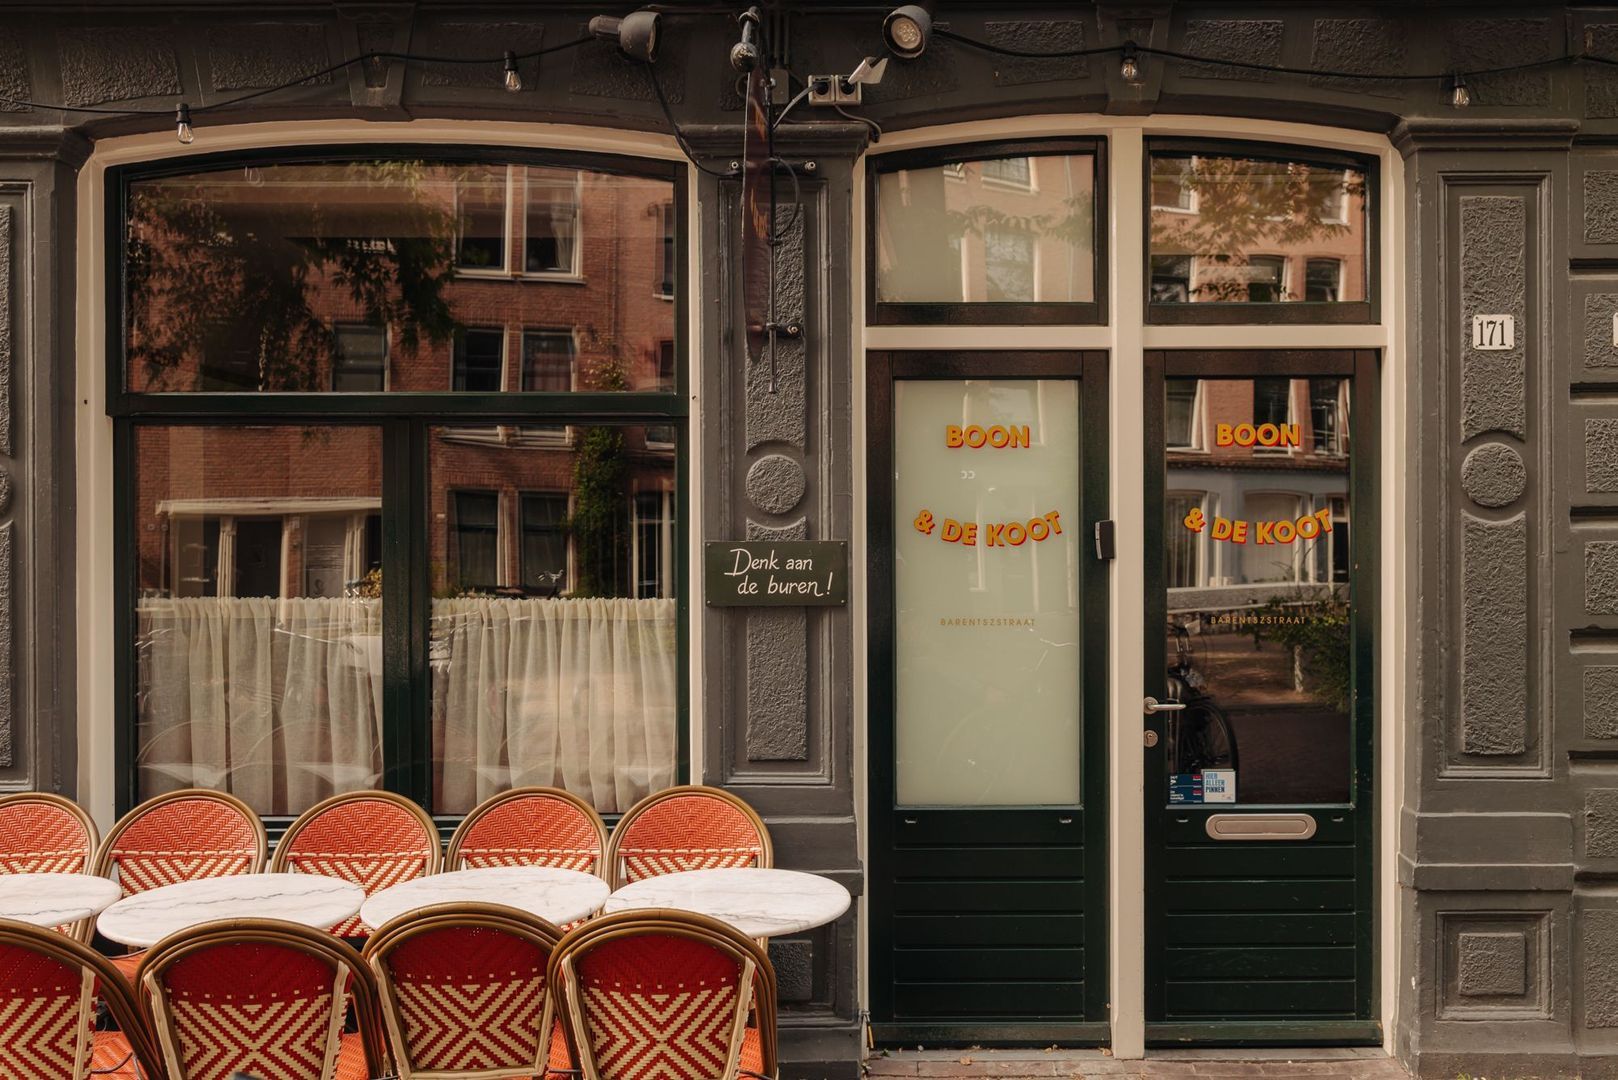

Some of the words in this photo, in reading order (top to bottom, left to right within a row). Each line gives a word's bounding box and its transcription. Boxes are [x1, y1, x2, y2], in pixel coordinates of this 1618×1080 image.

[1478, 320, 1506, 346] 171
[945, 424, 1030, 449] BOON
[1216, 423, 1301, 447] BOON
[913, 509, 936, 535] &
[941, 518, 978, 546] DE
[986, 510, 1062, 547] KOOT
[1183, 507, 1206, 533] &
[1211, 516, 1248, 545] DE
[1256, 508, 1332, 545] KOOT
[724, 548, 780, 577] Denk
[785, 558, 812, 571] aan
[737, 575, 759, 595] de
[767, 571, 833, 597] buren!
[940, 618, 1035, 627] BARENTSZSTRAAT
[1210, 616, 1306, 625] BARENTSZSTRAAT
